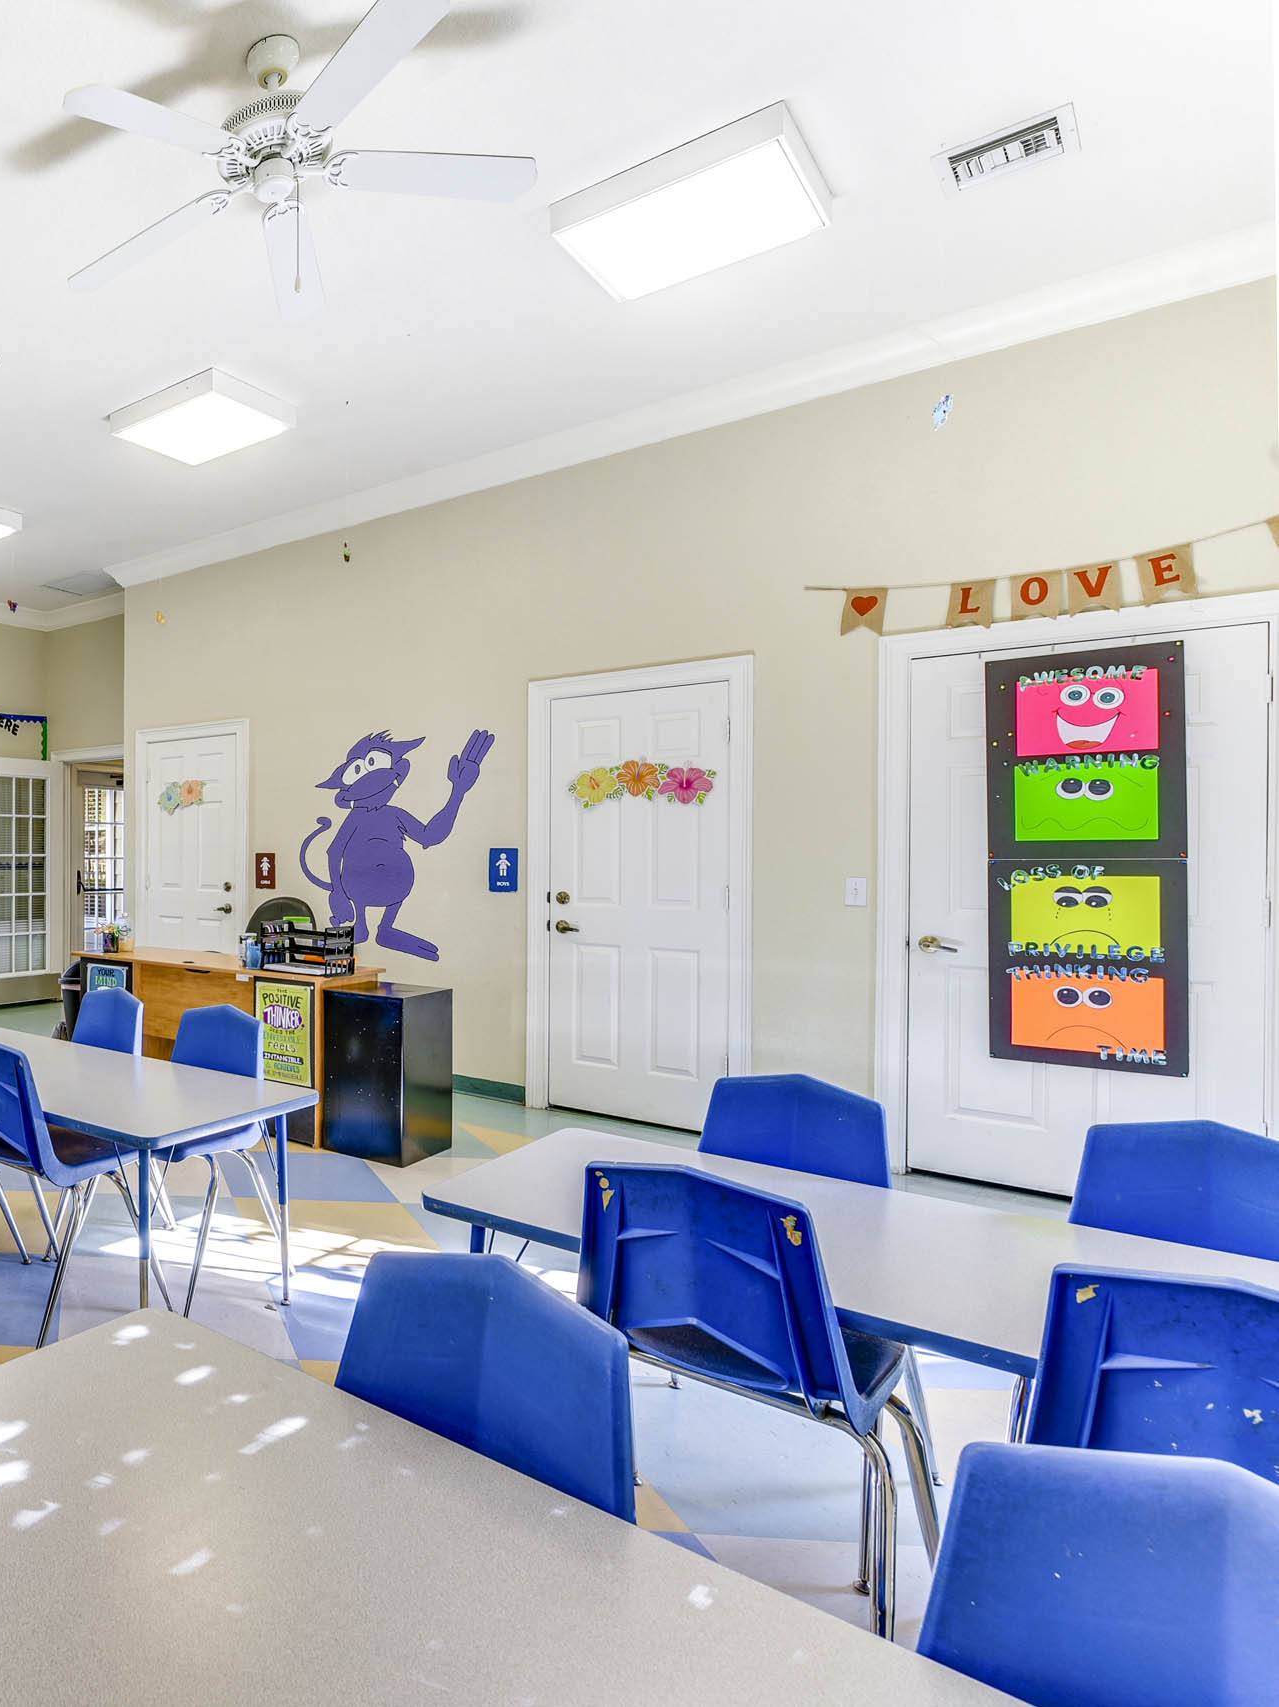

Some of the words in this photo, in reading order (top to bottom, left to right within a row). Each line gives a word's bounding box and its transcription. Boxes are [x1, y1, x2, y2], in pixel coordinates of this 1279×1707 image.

[958, 552, 1181, 615] LOVE
[1019, 664, 1148, 692] AWESOME
[1018, 753, 1161, 777] WARNING
[997, 863, 1063, 891] LOSS
[1072, 864, 1105, 880] OF
[1007, 941, 1166, 963] PRIVILEGE
[95, 975, 118, 987] MIND
[97, 968, 115, 977] YOUR
[1005, 963, 1150, 984] THINKING
[262, 992, 304, 1010] POSITIVE
[264, 1005, 300, 1029] THINKER
[1097, 1044, 1168, 1066] TIME
